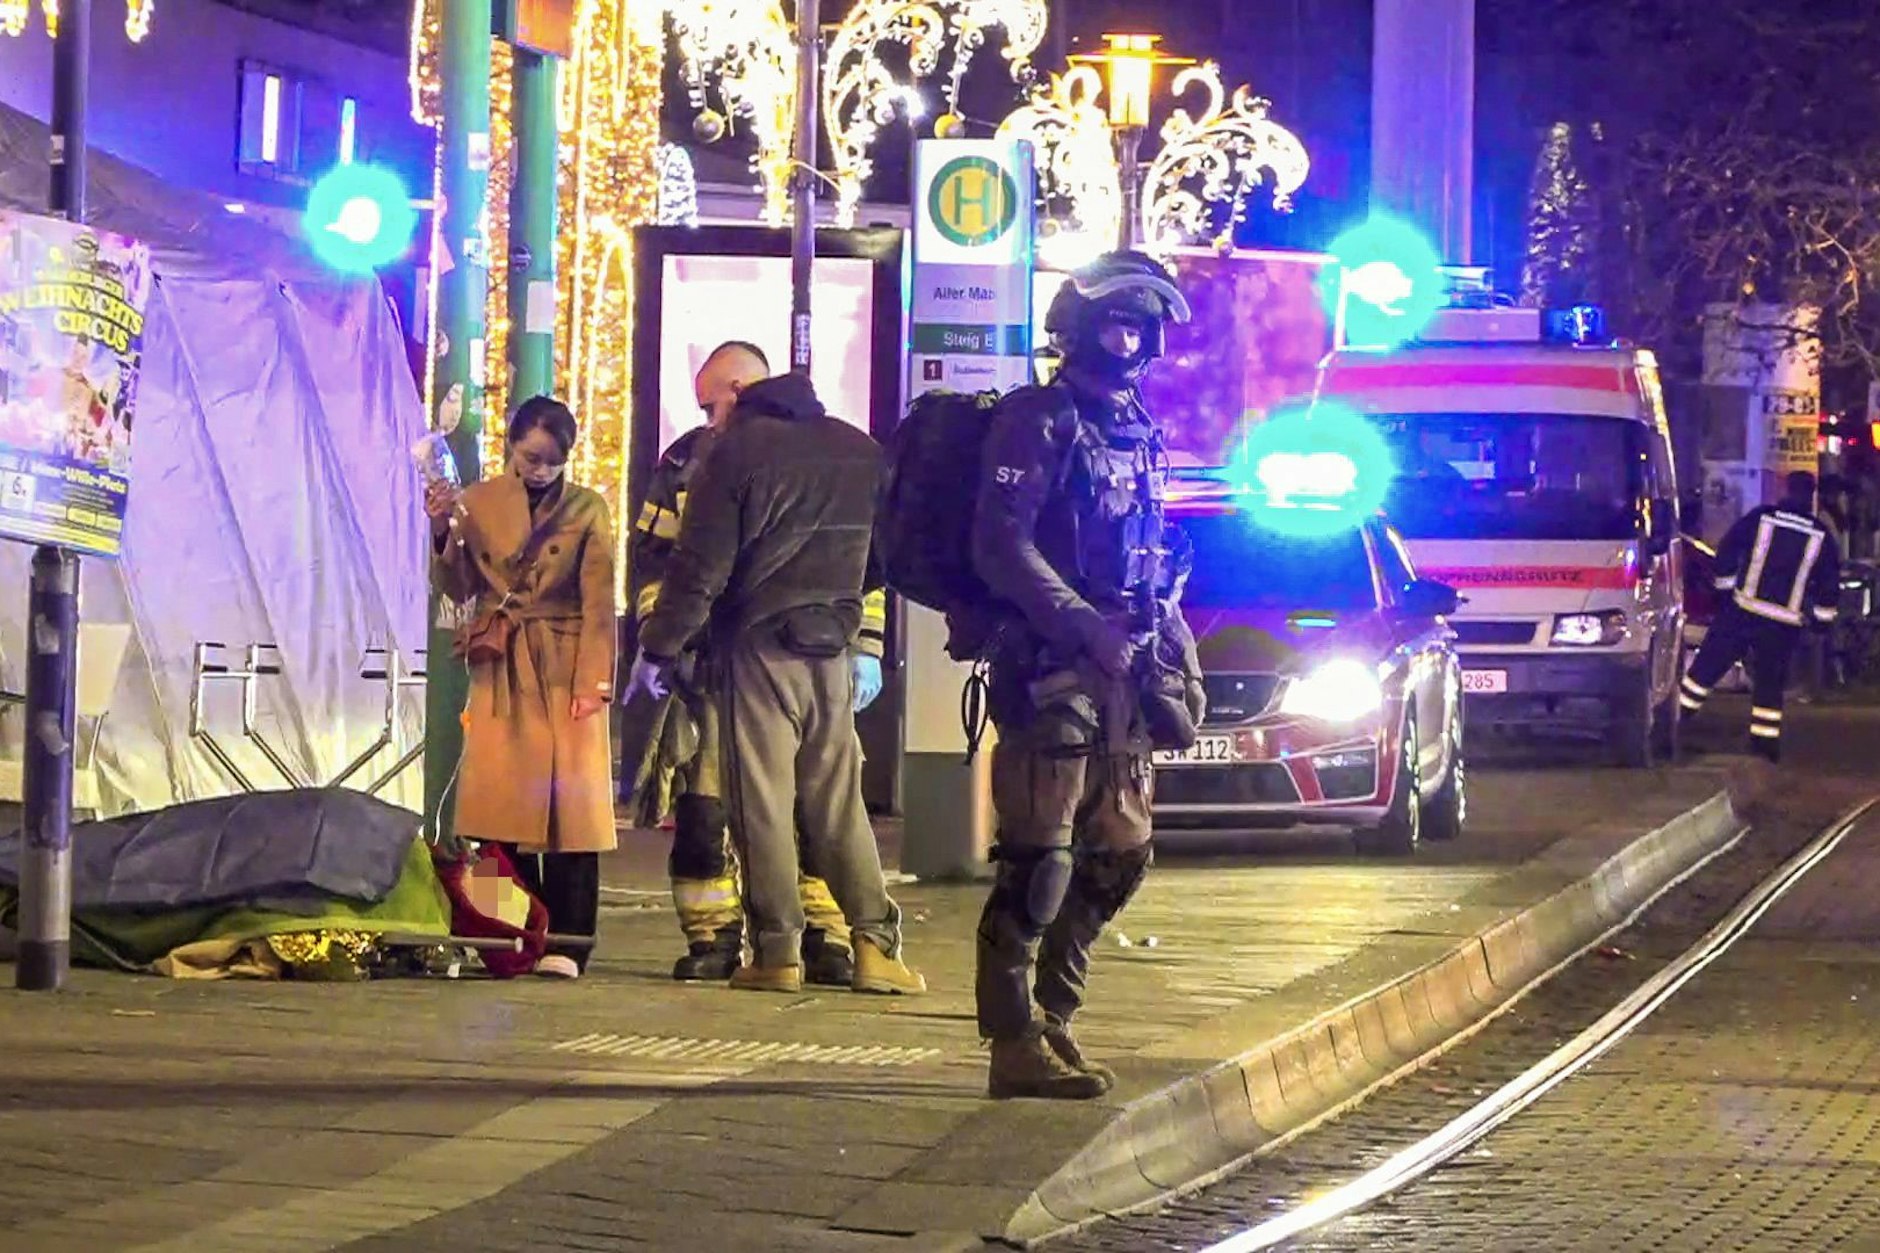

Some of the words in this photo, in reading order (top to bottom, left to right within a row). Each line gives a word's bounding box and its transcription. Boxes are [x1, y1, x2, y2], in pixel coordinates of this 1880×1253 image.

[954, 175, 991, 225] H
[54, 309, 129, 354] CIRCUS
[996, 466, 1025, 484] ST
[1464, 673, 1494, 689] 285
[1193, 740, 1228, 760] 112
